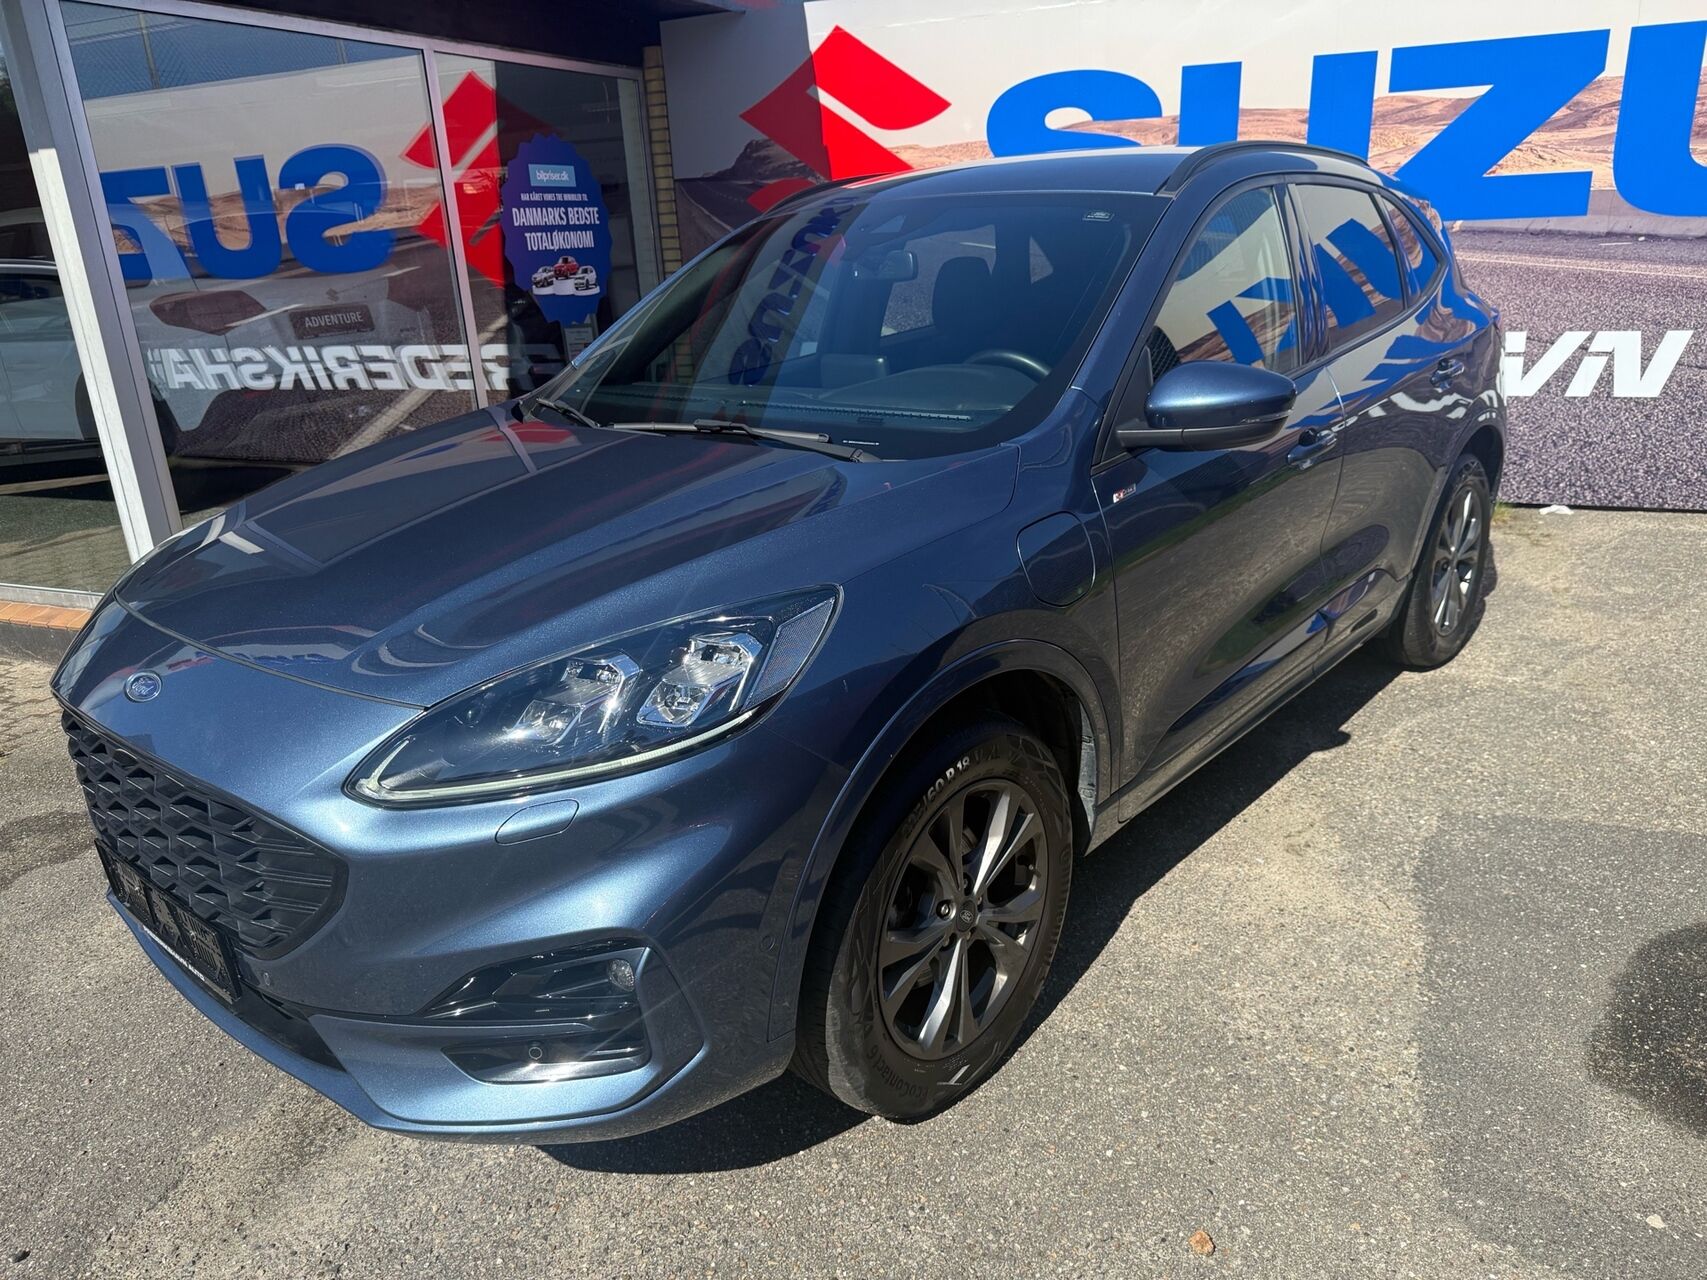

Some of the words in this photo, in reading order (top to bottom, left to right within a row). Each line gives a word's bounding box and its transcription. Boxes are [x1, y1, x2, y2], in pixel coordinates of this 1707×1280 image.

[536, 169, 570, 182] bilpriser.dk
[512, 207, 567, 226] DANMARKS
[567, 207, 600, 225] BEDSTE
[524, 230, 594, 252] TOTALØKONOMI
[304, 310, 363, 329] ADVENTURE
[956, 755, 971, 772] 18
